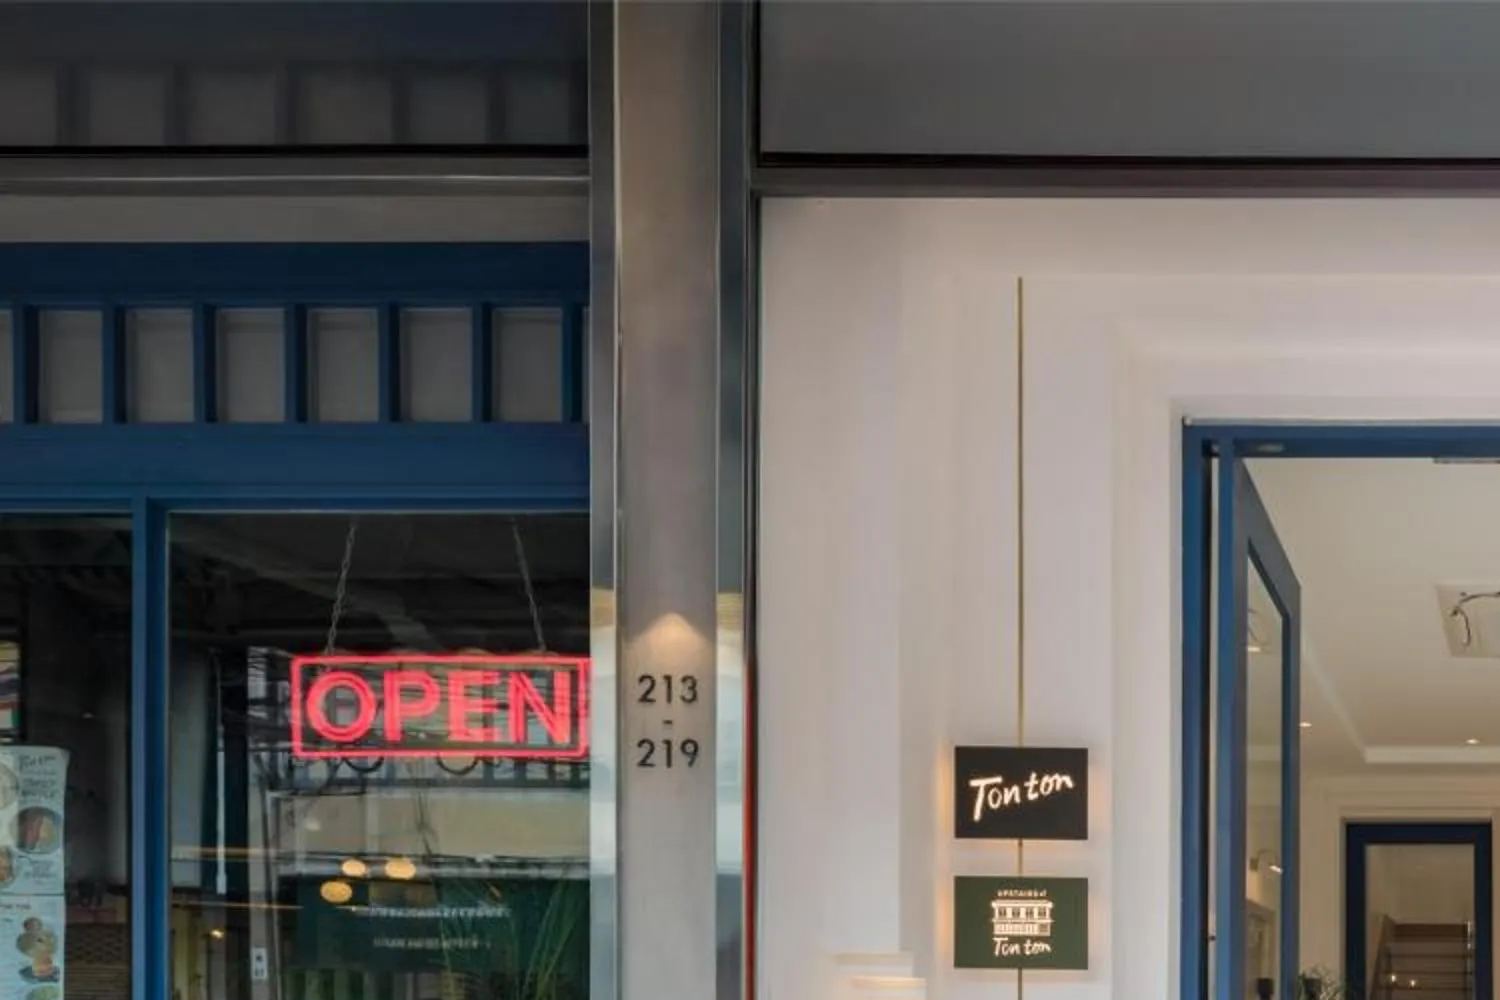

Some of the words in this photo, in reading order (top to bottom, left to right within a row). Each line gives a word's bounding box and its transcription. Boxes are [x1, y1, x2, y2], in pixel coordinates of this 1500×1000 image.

[637, 674, 699, 704] 213
[306, 670, 571, 743] OPEN
[636, 738, 700, 769] 219
